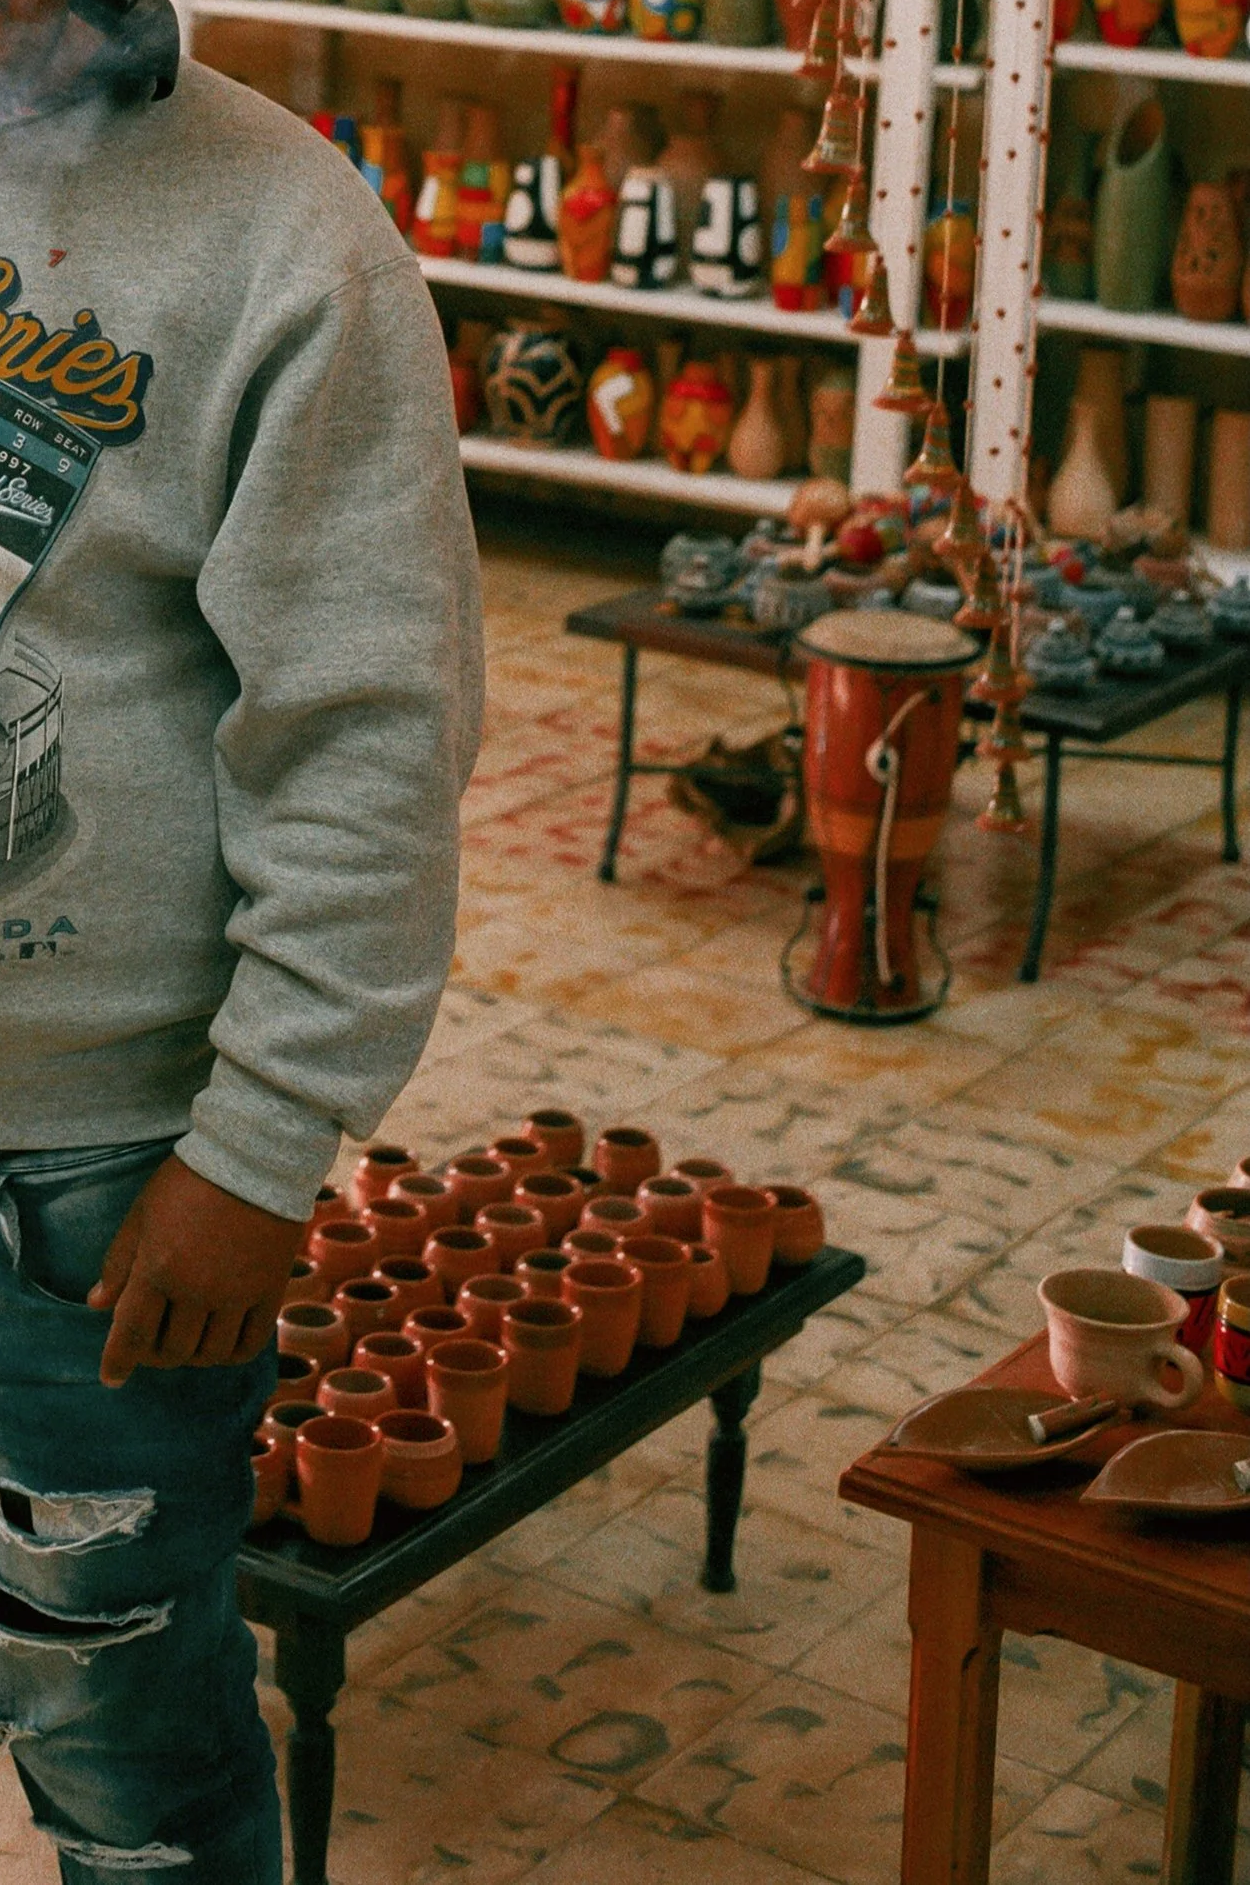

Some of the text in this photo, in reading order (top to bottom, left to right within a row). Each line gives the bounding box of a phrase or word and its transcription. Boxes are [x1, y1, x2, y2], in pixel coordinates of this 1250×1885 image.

[12, 432, 27, 450] 3
[57, 457, 72, 473] 9
[13, 408, 44, 431] ROW
[53, 433, 87, 459] SEAT
